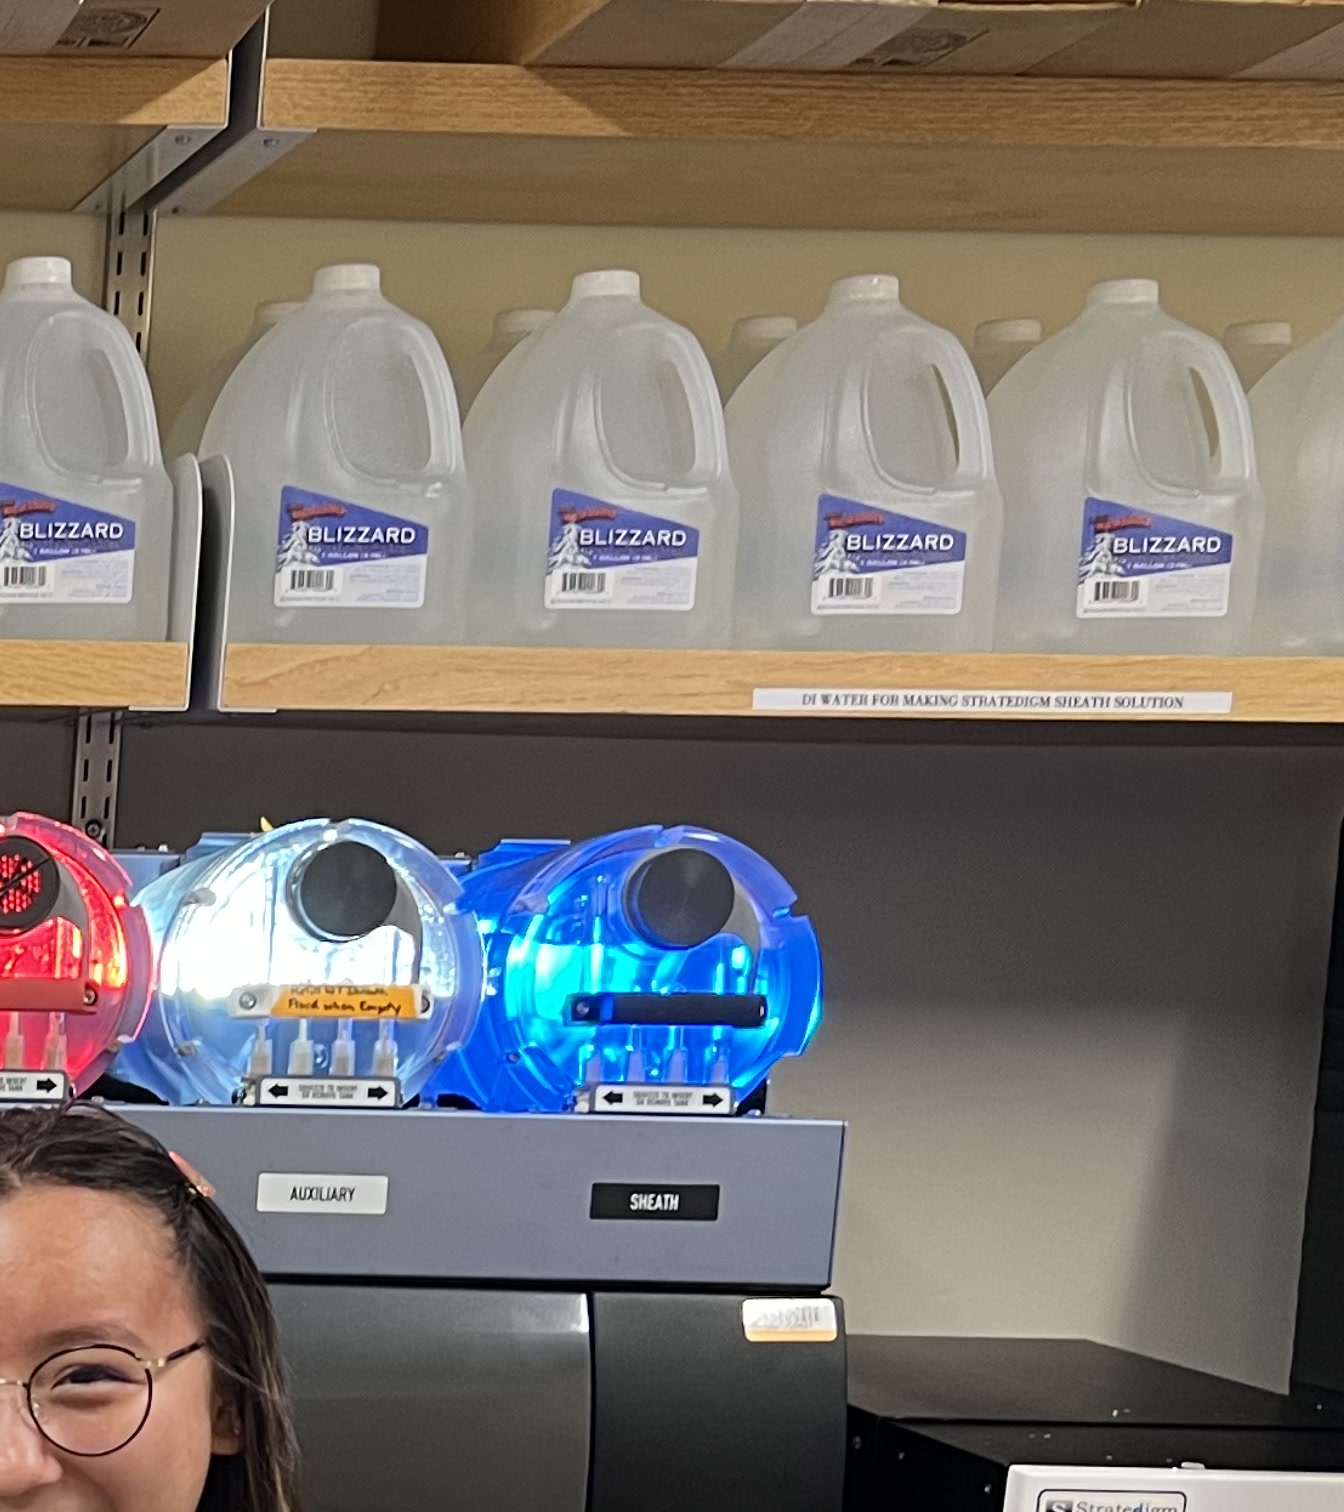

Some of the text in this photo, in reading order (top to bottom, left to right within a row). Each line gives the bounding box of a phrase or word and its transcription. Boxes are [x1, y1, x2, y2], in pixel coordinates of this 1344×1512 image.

[19, 522, 124, 540] BLIZZARD
[307, 526, 415, 544] BLIZZARD
[579, 529, 687, 547] BLIZZARD
[846, 534, 954, 551] BLIZZARD
[1112, 536, 1222, 554] BLIZZARD
[801, 694, 1184, 709] DI WATER FOR MAKING STRATEDIGM SHEATH SOLUTION
[289, 1185, 357, 1202] AUXILIARY
[629, 1192, 679, 1212] SHEATH
